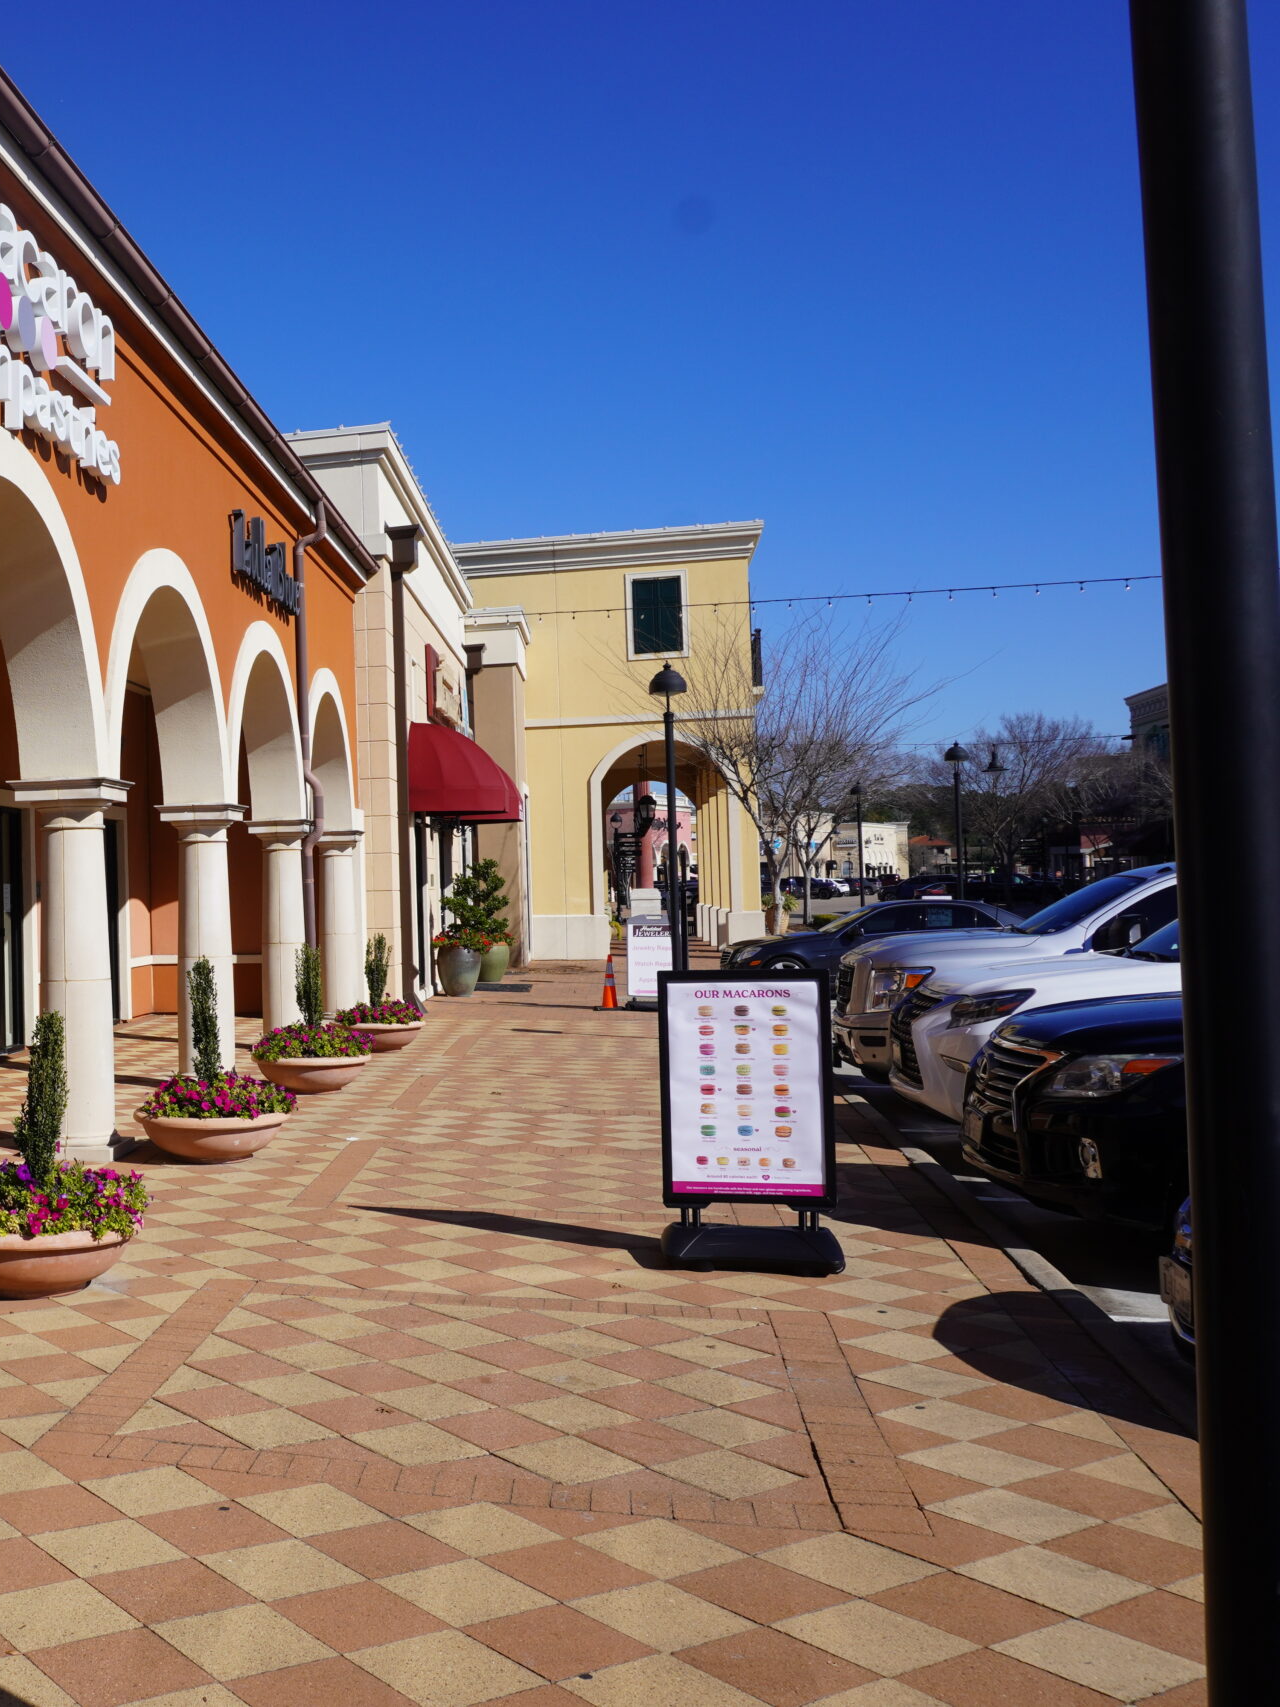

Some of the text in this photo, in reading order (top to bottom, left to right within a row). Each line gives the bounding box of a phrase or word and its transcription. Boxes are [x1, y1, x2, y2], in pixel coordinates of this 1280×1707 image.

[4, 359, 121, 486] pastries
[634, 929, 672, 937] JEWELER
[694, 989, 791, 999] OUR MACARONS
